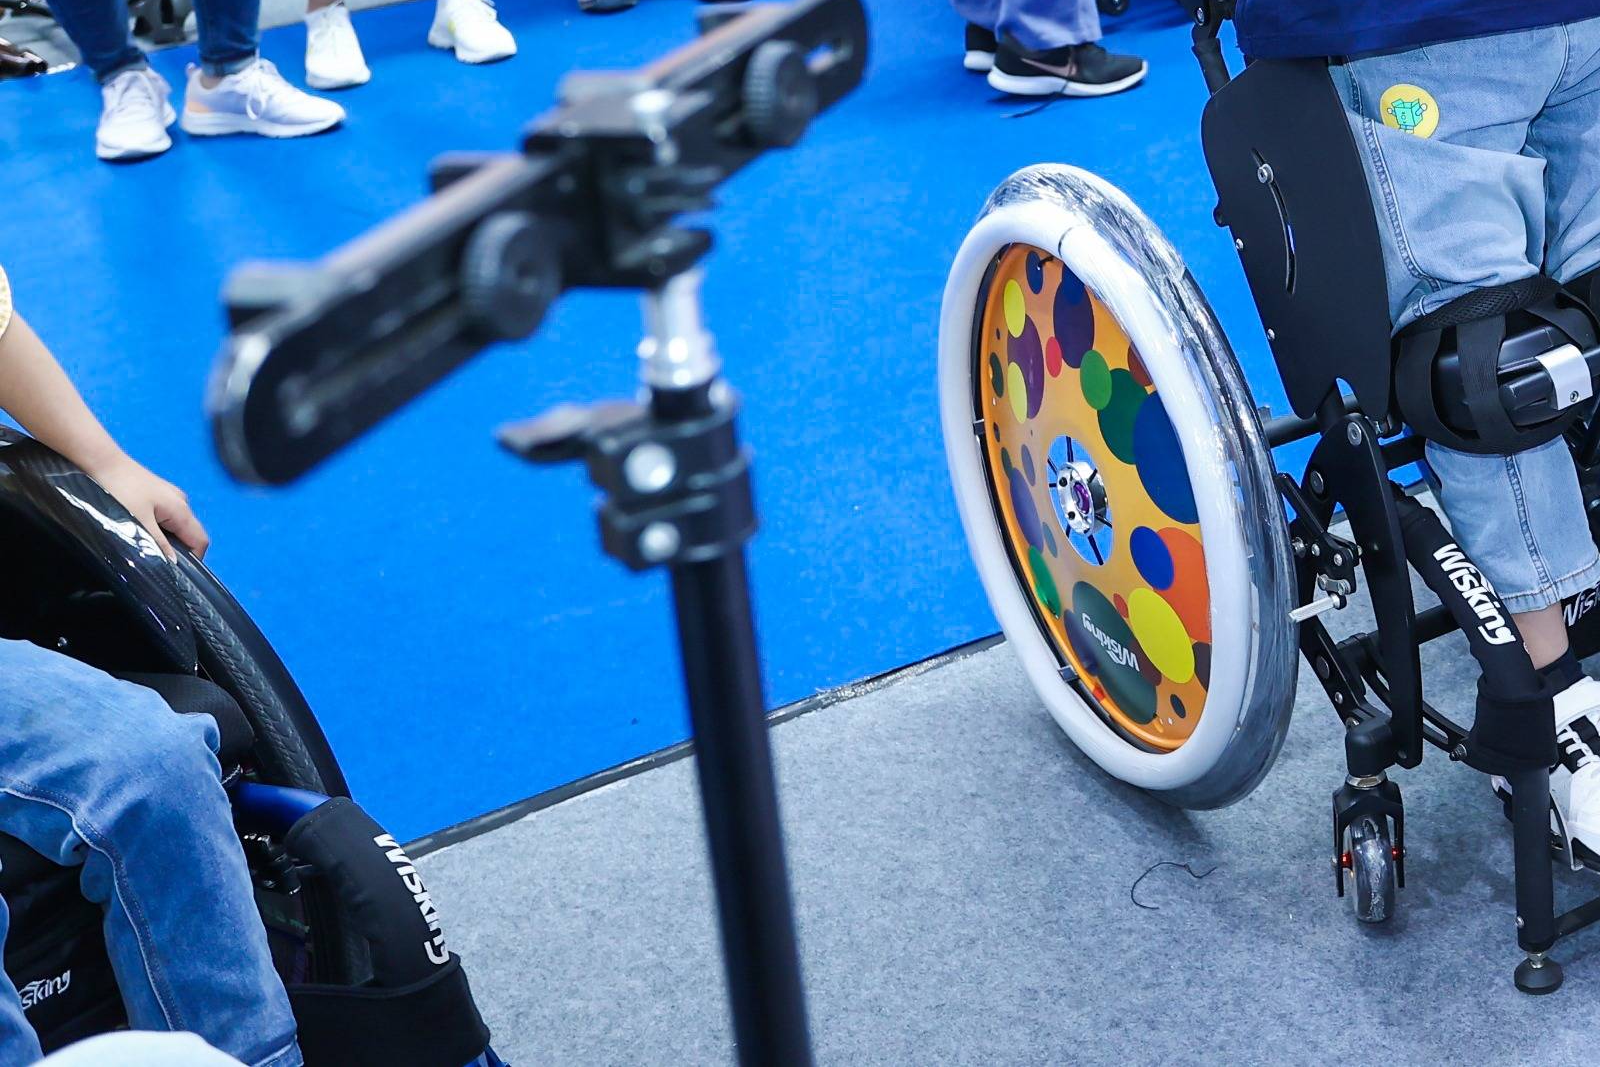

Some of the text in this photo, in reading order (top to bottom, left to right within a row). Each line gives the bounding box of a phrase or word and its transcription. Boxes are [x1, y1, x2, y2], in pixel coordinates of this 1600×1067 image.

[1432, 543, 1517, 645] Wisking
[1081, 612, 1140, 672] Wisking
[18, 969, 71, 1010] sking
